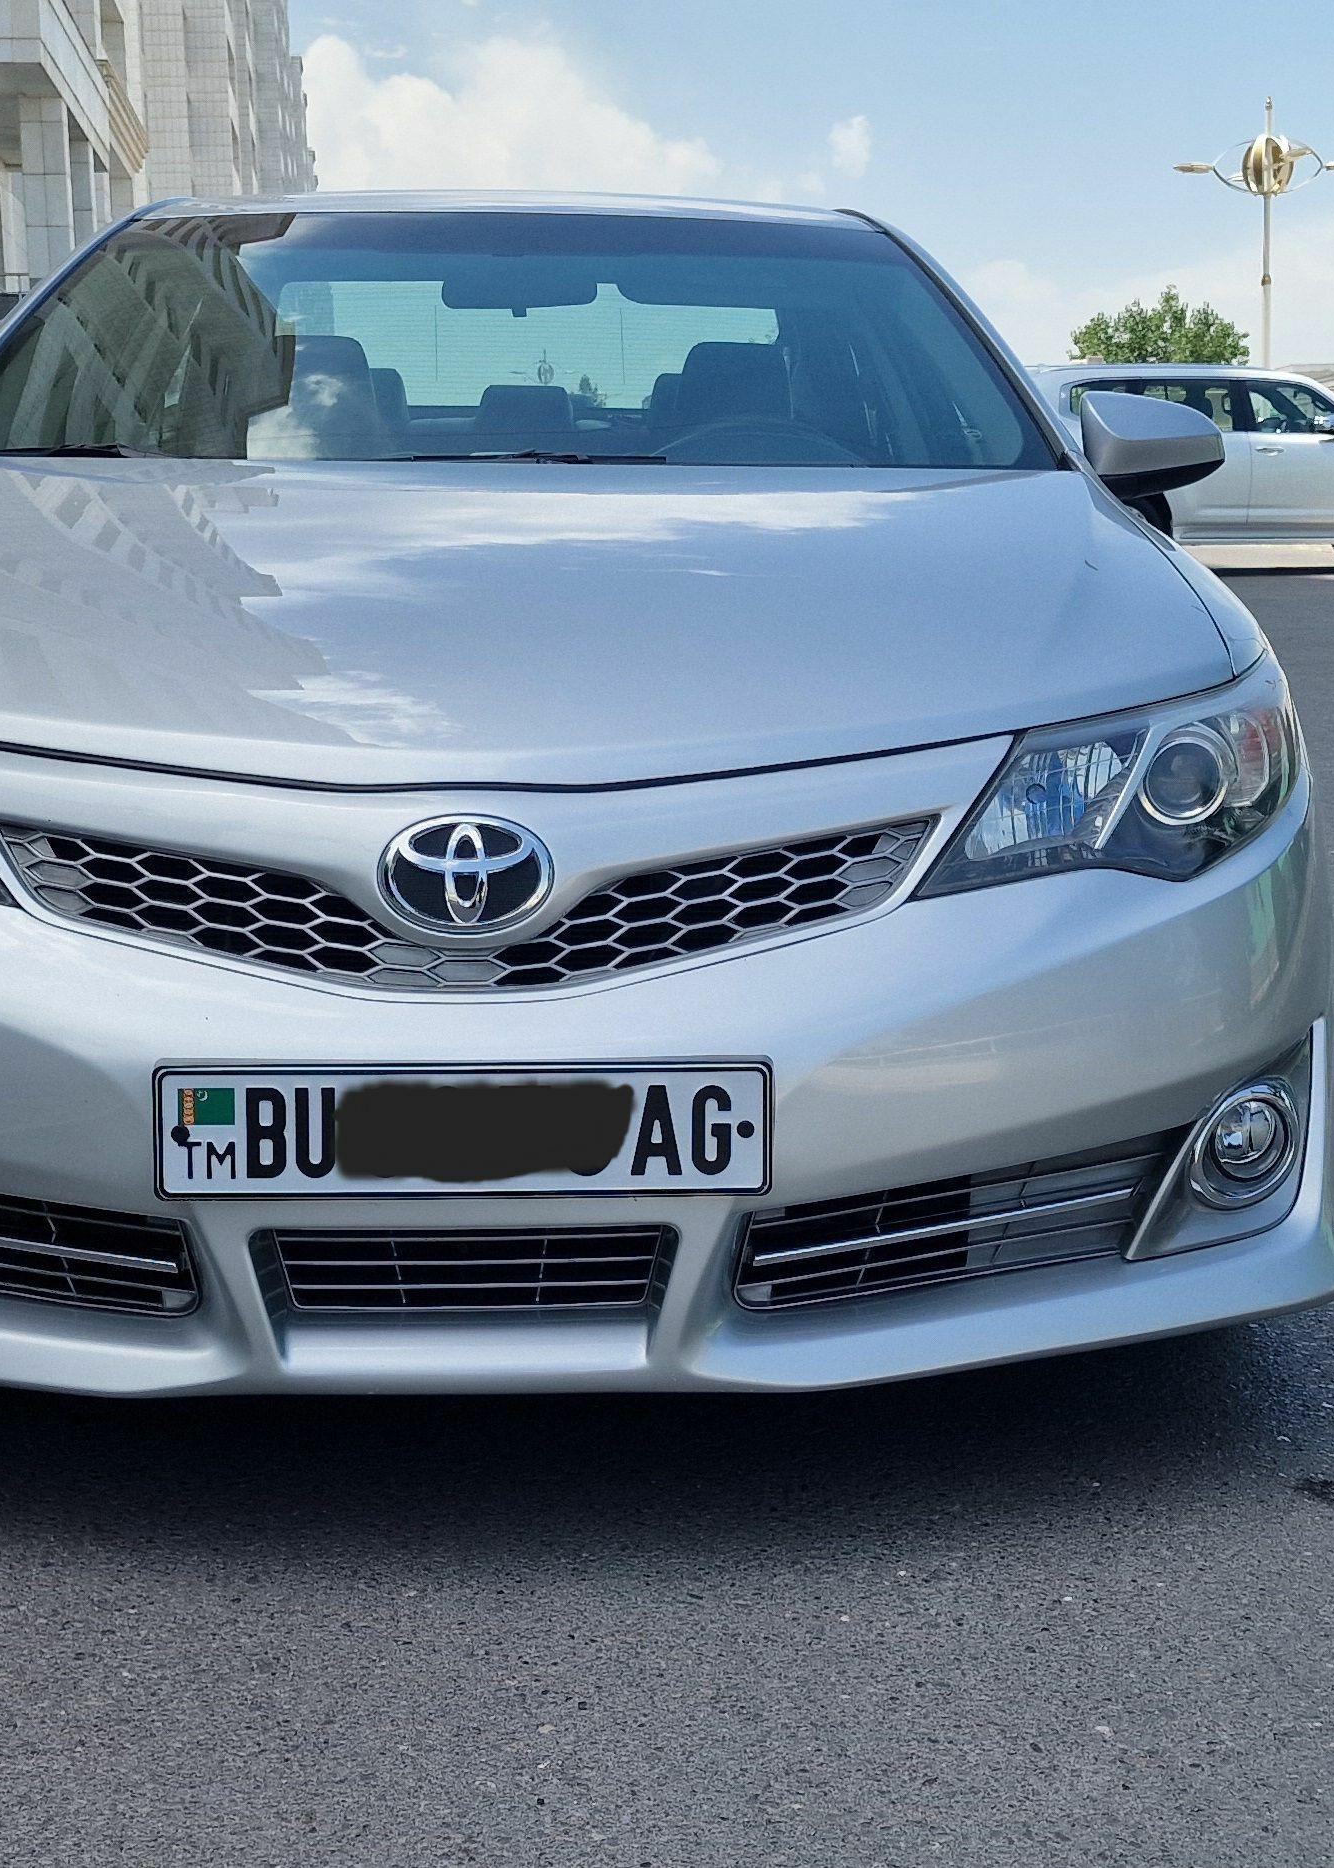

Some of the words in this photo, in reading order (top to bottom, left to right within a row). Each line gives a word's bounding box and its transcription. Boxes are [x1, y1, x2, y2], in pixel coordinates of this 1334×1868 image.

[177, 1140, 237, 1181] TM
[245, 1087, 336, 1179] BU
[630, 1084, 733, 1177] AG
